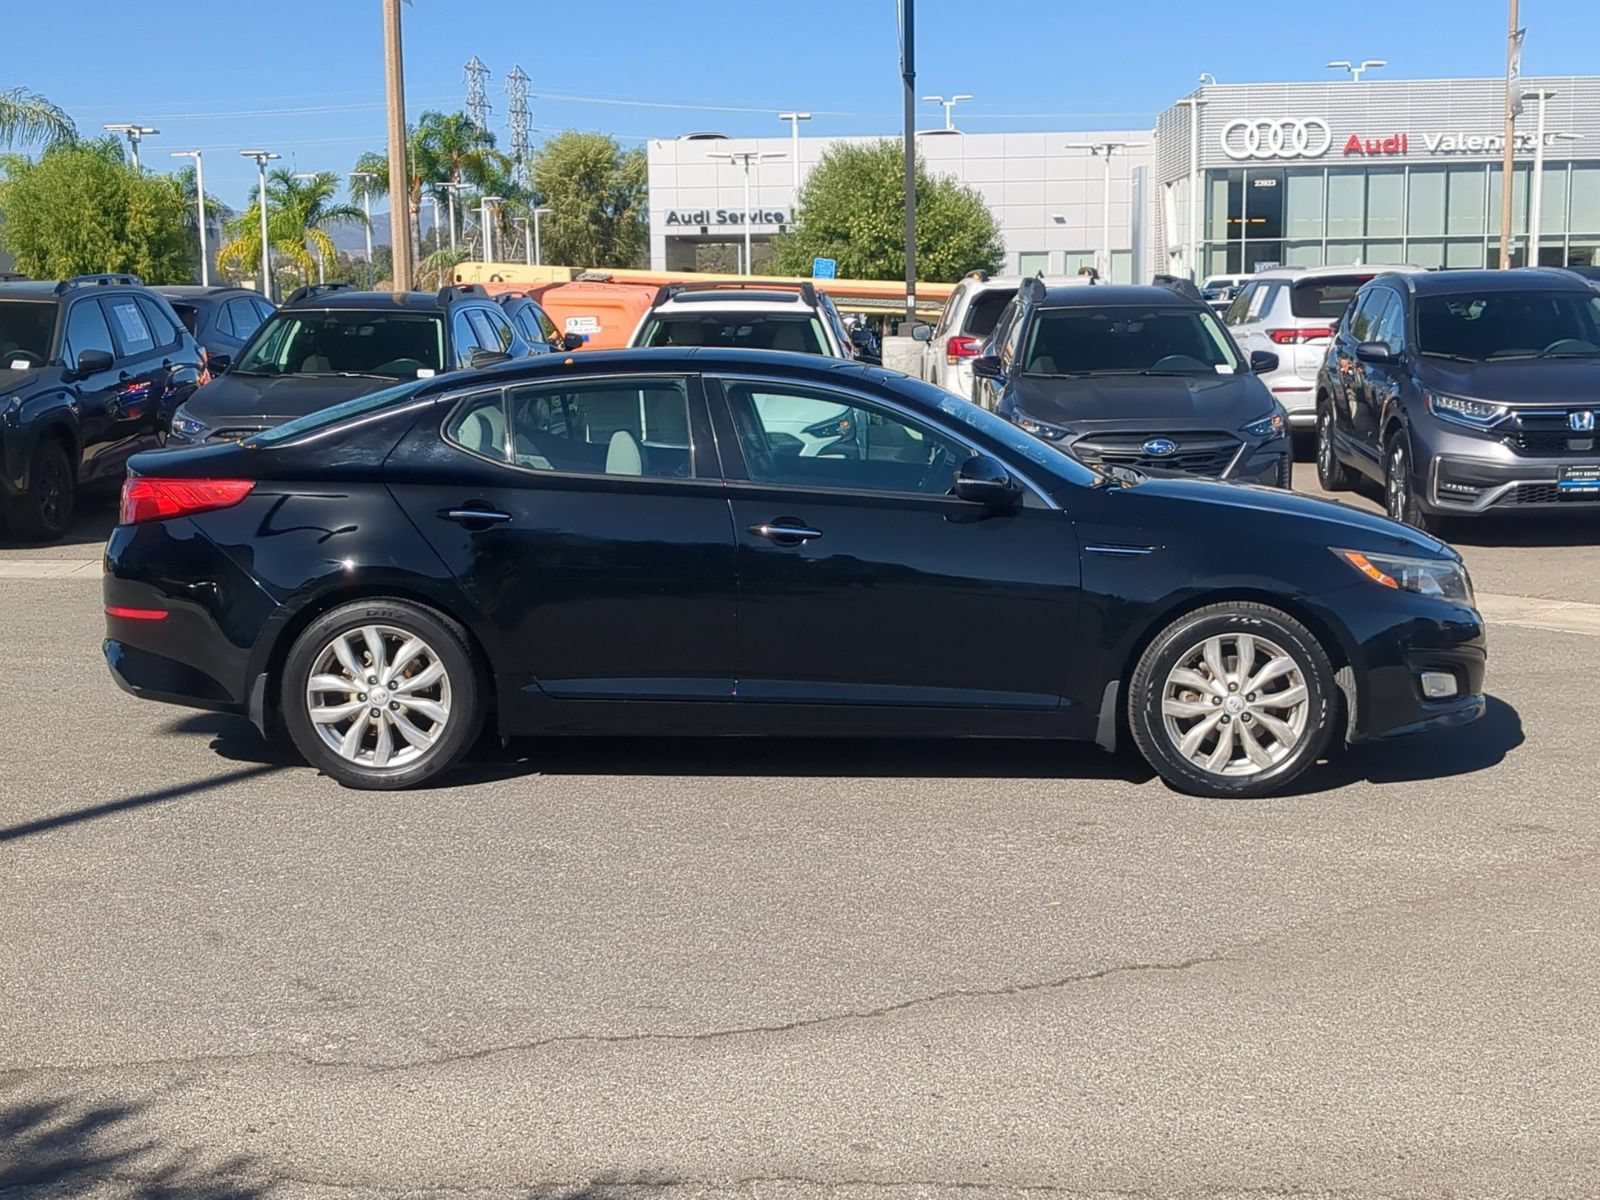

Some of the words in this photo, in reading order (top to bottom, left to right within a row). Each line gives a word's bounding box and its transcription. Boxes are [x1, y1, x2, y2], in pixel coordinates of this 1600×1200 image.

[1344, 133, 1408, 155] Audi
[666, 210, 710, 226] Audi
[715, 209, 784, 225] Service
